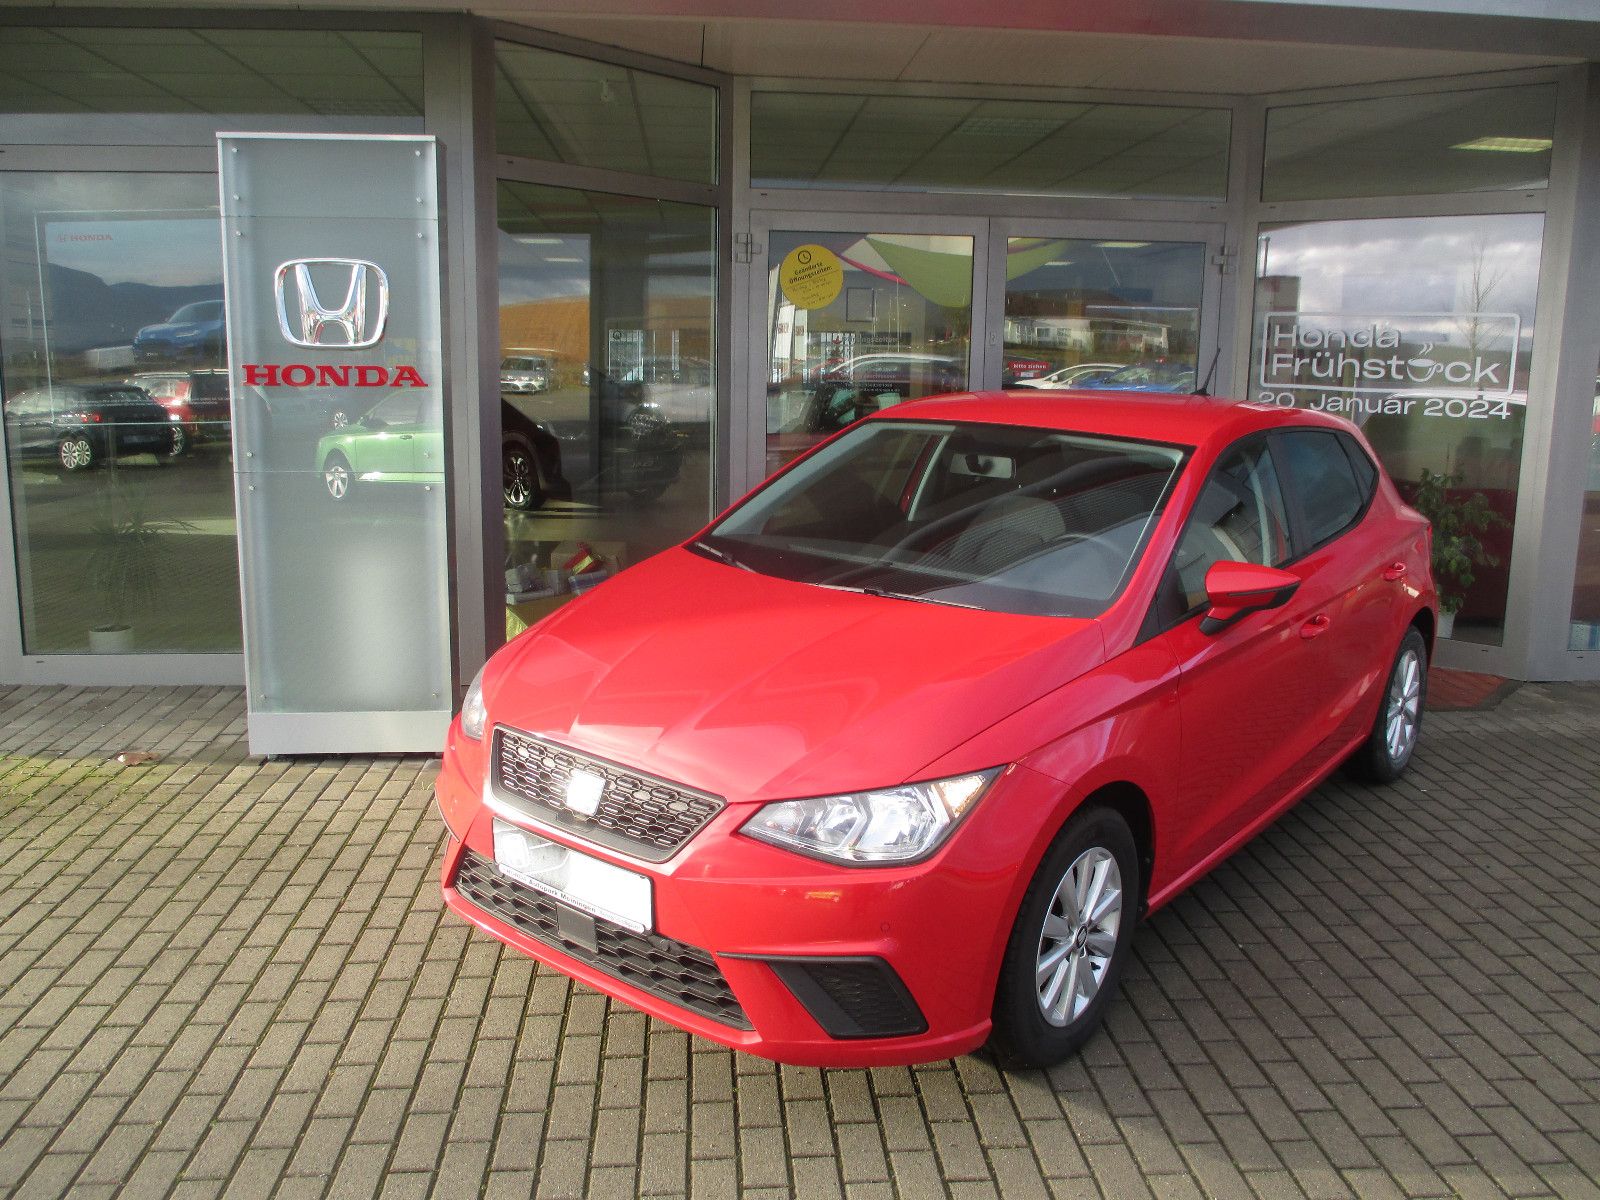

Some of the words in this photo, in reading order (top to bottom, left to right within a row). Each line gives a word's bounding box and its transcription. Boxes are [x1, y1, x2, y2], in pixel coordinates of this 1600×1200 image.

[1272, 323, 1400, 348] Honda
[241, 364, 429, 387] HONDA
[1309, 393, 1417, 415] Januar
[1422, 398, 1511, 420] 2024
